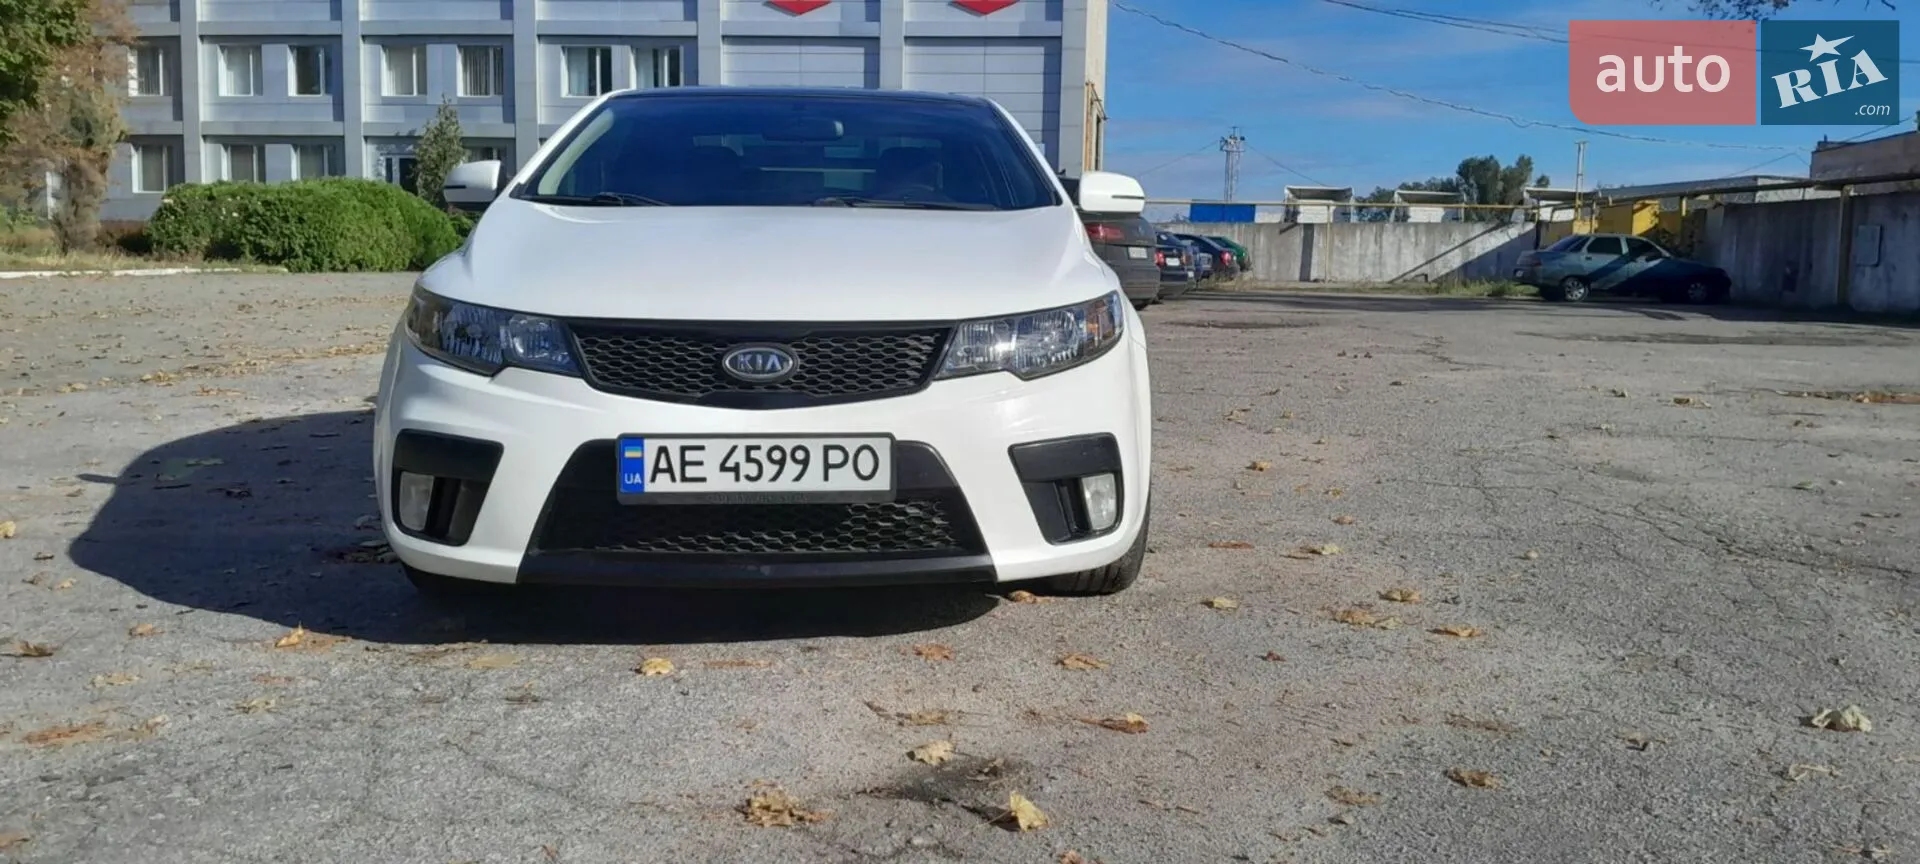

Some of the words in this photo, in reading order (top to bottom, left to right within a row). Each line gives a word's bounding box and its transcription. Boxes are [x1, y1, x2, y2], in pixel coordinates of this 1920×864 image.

[737, 353, 782, 371] KIA
[649, 444, 707, 484] AE
[719, 443, 811, 483] 4599
[822, 443, 880, 482] PO
[624, 473, 643, 485] UA
